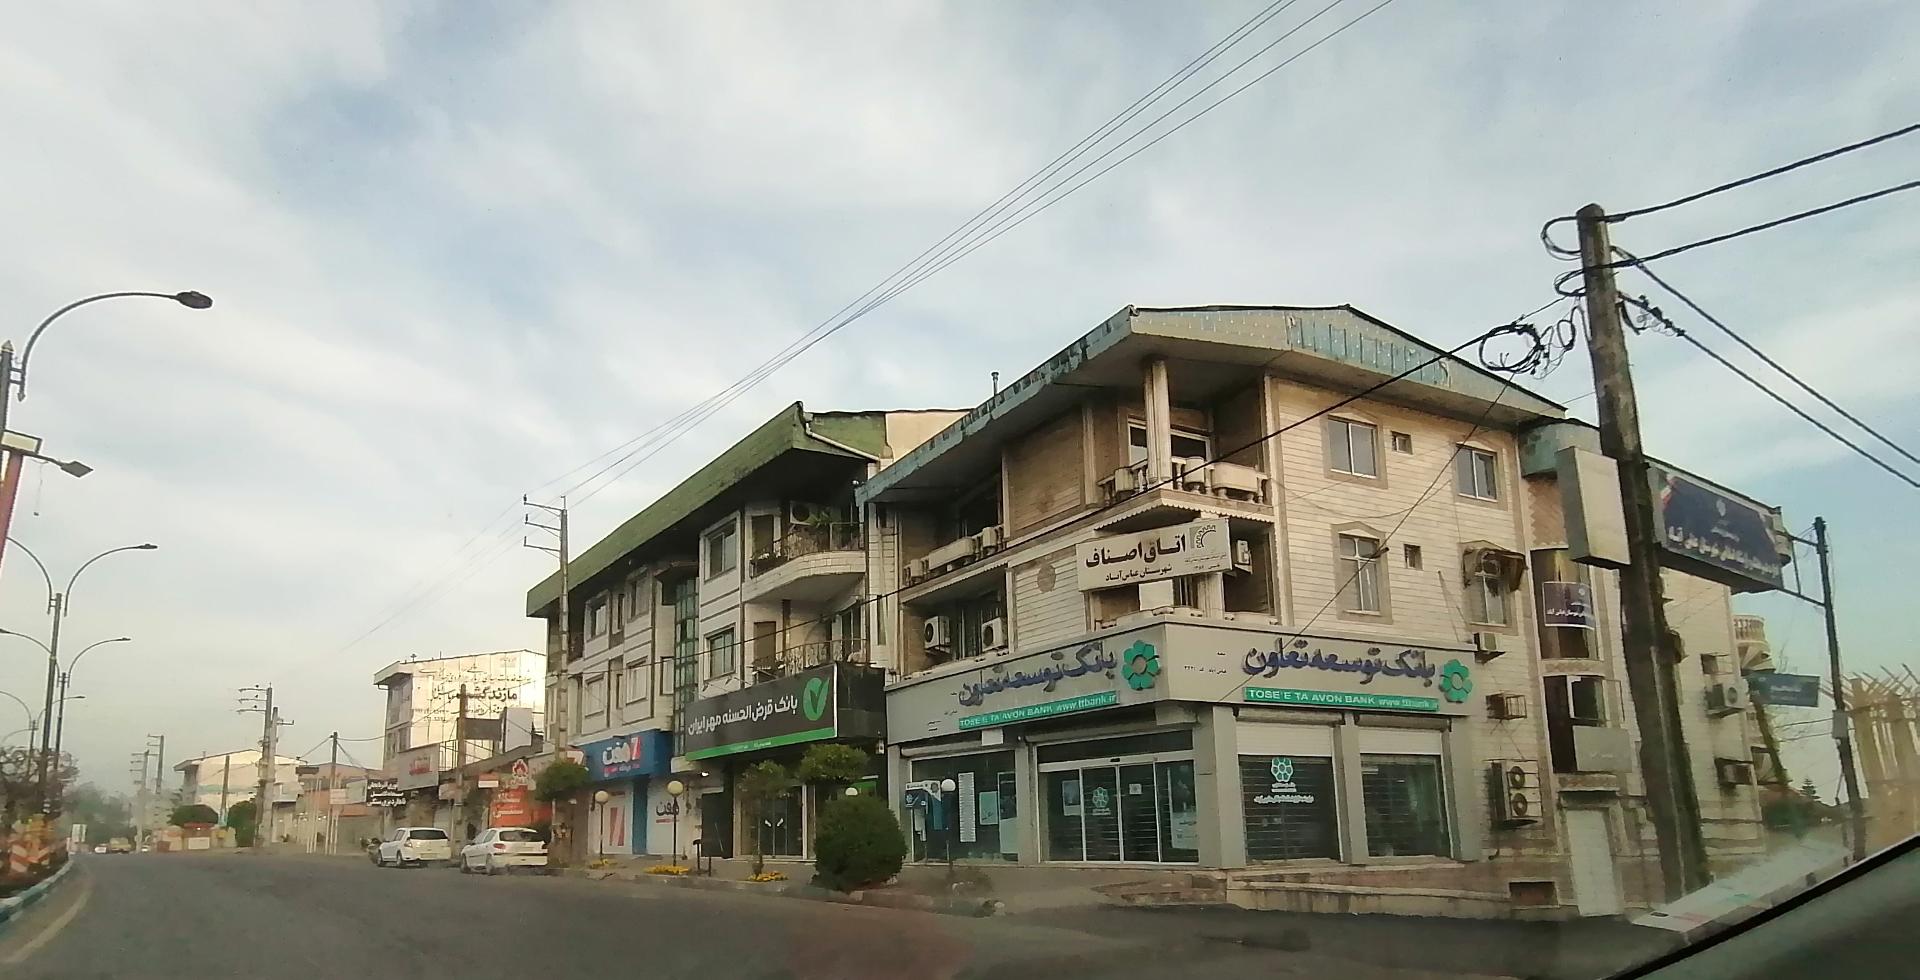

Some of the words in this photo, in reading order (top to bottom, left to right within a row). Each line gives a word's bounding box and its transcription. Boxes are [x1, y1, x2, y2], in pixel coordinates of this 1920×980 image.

[1086, 541, 1142, 568] اصناف
[1144, 533, 1186, 563] اتاق
[1106, 570, 1122, 581] آباد
[1122, 569, 1139, 581] عباس
[1140, 563, 1172, 578] شهرستان
[1062, 640, 1118, 680] بانک
[1242, 637, 1309, 678] تعاون
[1307, 647, 1382, 685] توسعه
[1002, 651, 1065, 692] توسعه
[1381, 649, 1436, 687] بانک
[774, 695, 798, 714] بانک
[1295, 691, 1308, 701] TA
[1311, 693, 1342, 703] AVON
[1345, 695, 1375, 705] BANK
[722, 704, 752, 724] الحسنه
[752, 700, 774, 721] قرض
[1003, 710, 1025, 720] AVON
[1027, 706, 1053, 716] BANK
[688, 715, 706, 735] ایران
[706, 715, 722, 732] مهر
